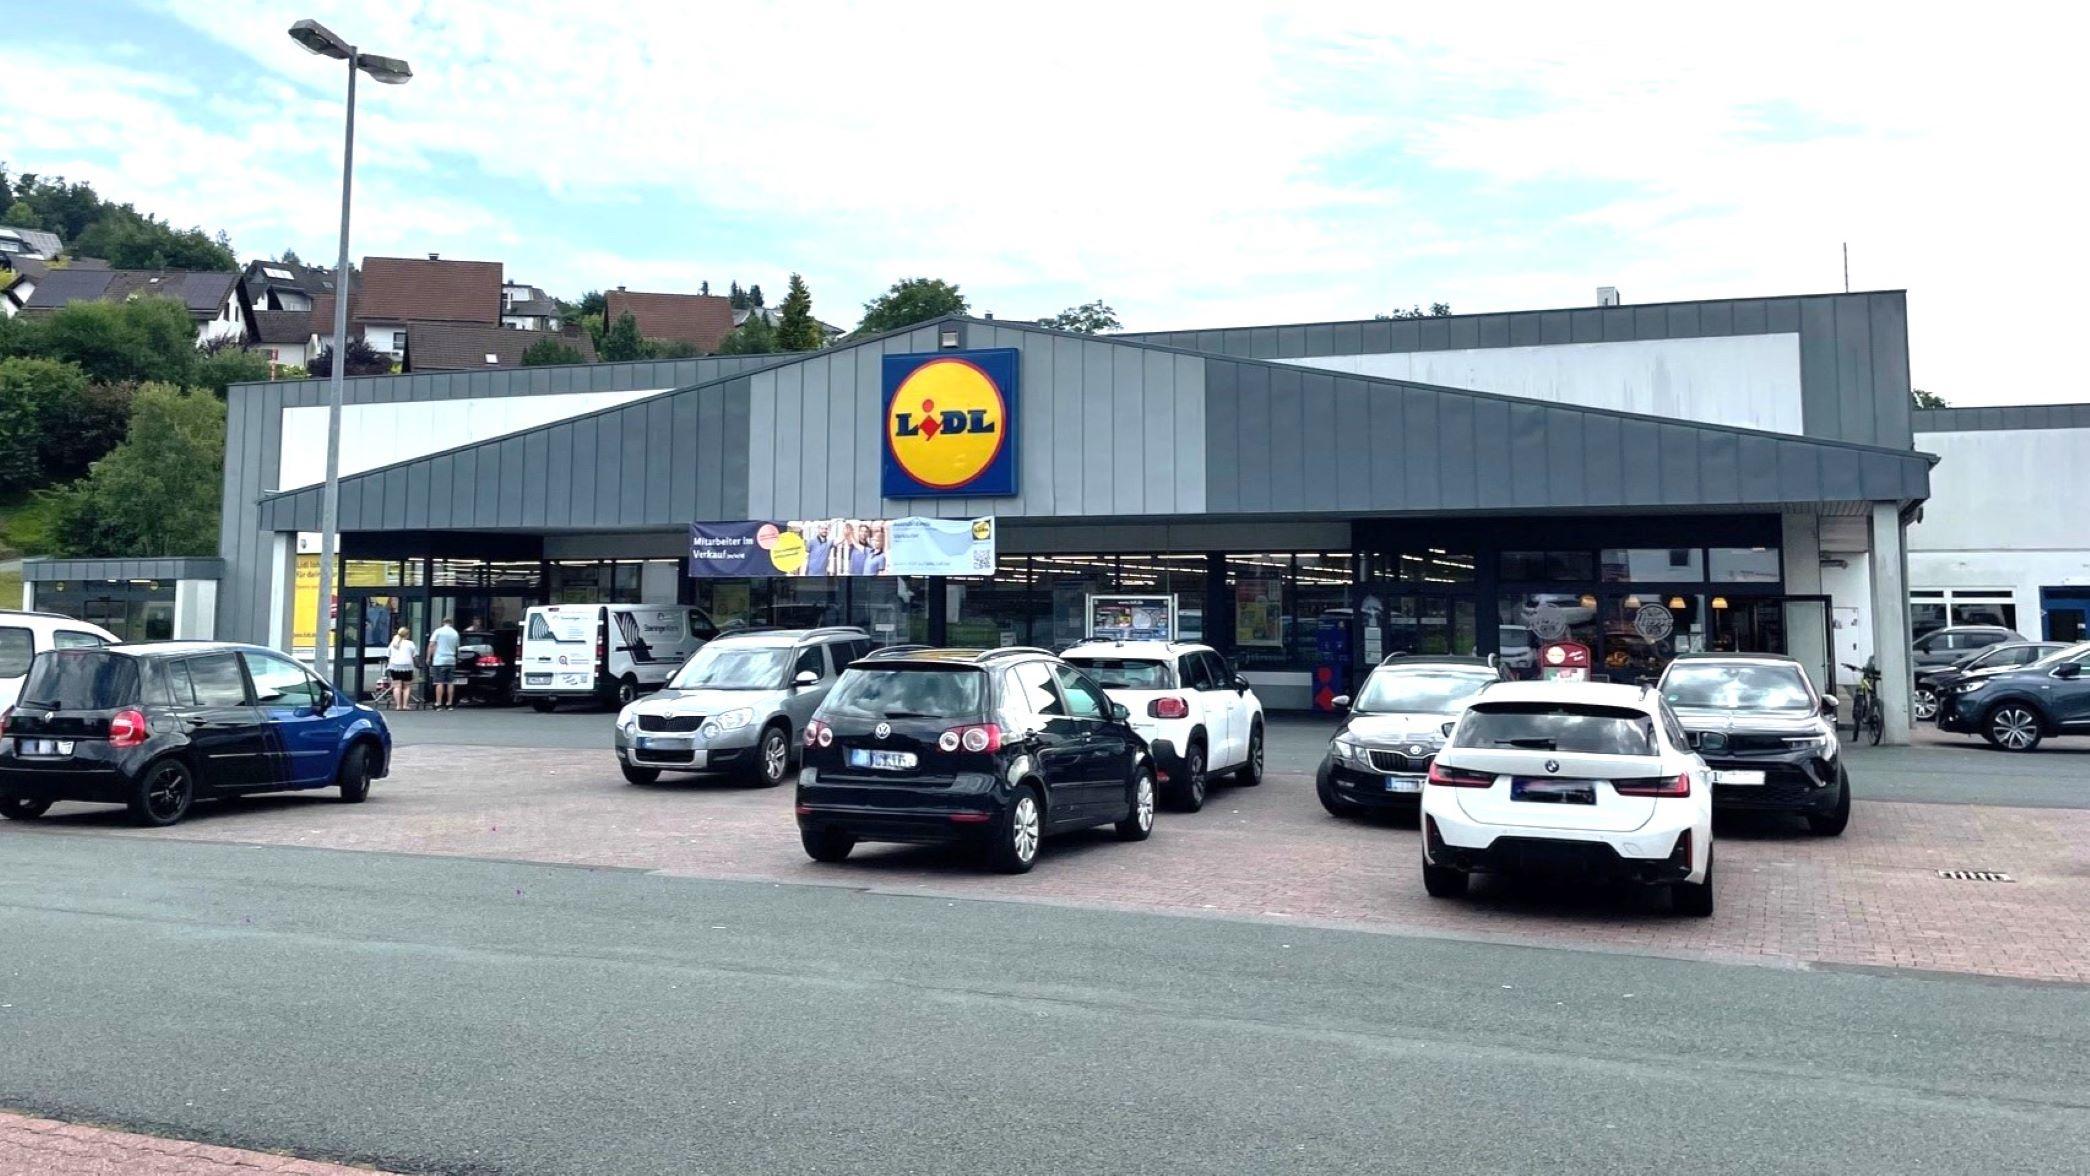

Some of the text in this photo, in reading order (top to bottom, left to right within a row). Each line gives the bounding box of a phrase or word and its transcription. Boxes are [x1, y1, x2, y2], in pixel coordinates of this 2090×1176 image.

[694, 537, 753, 546] Mitarbeiter im
[693, 550, 726, 559] Verkauf
